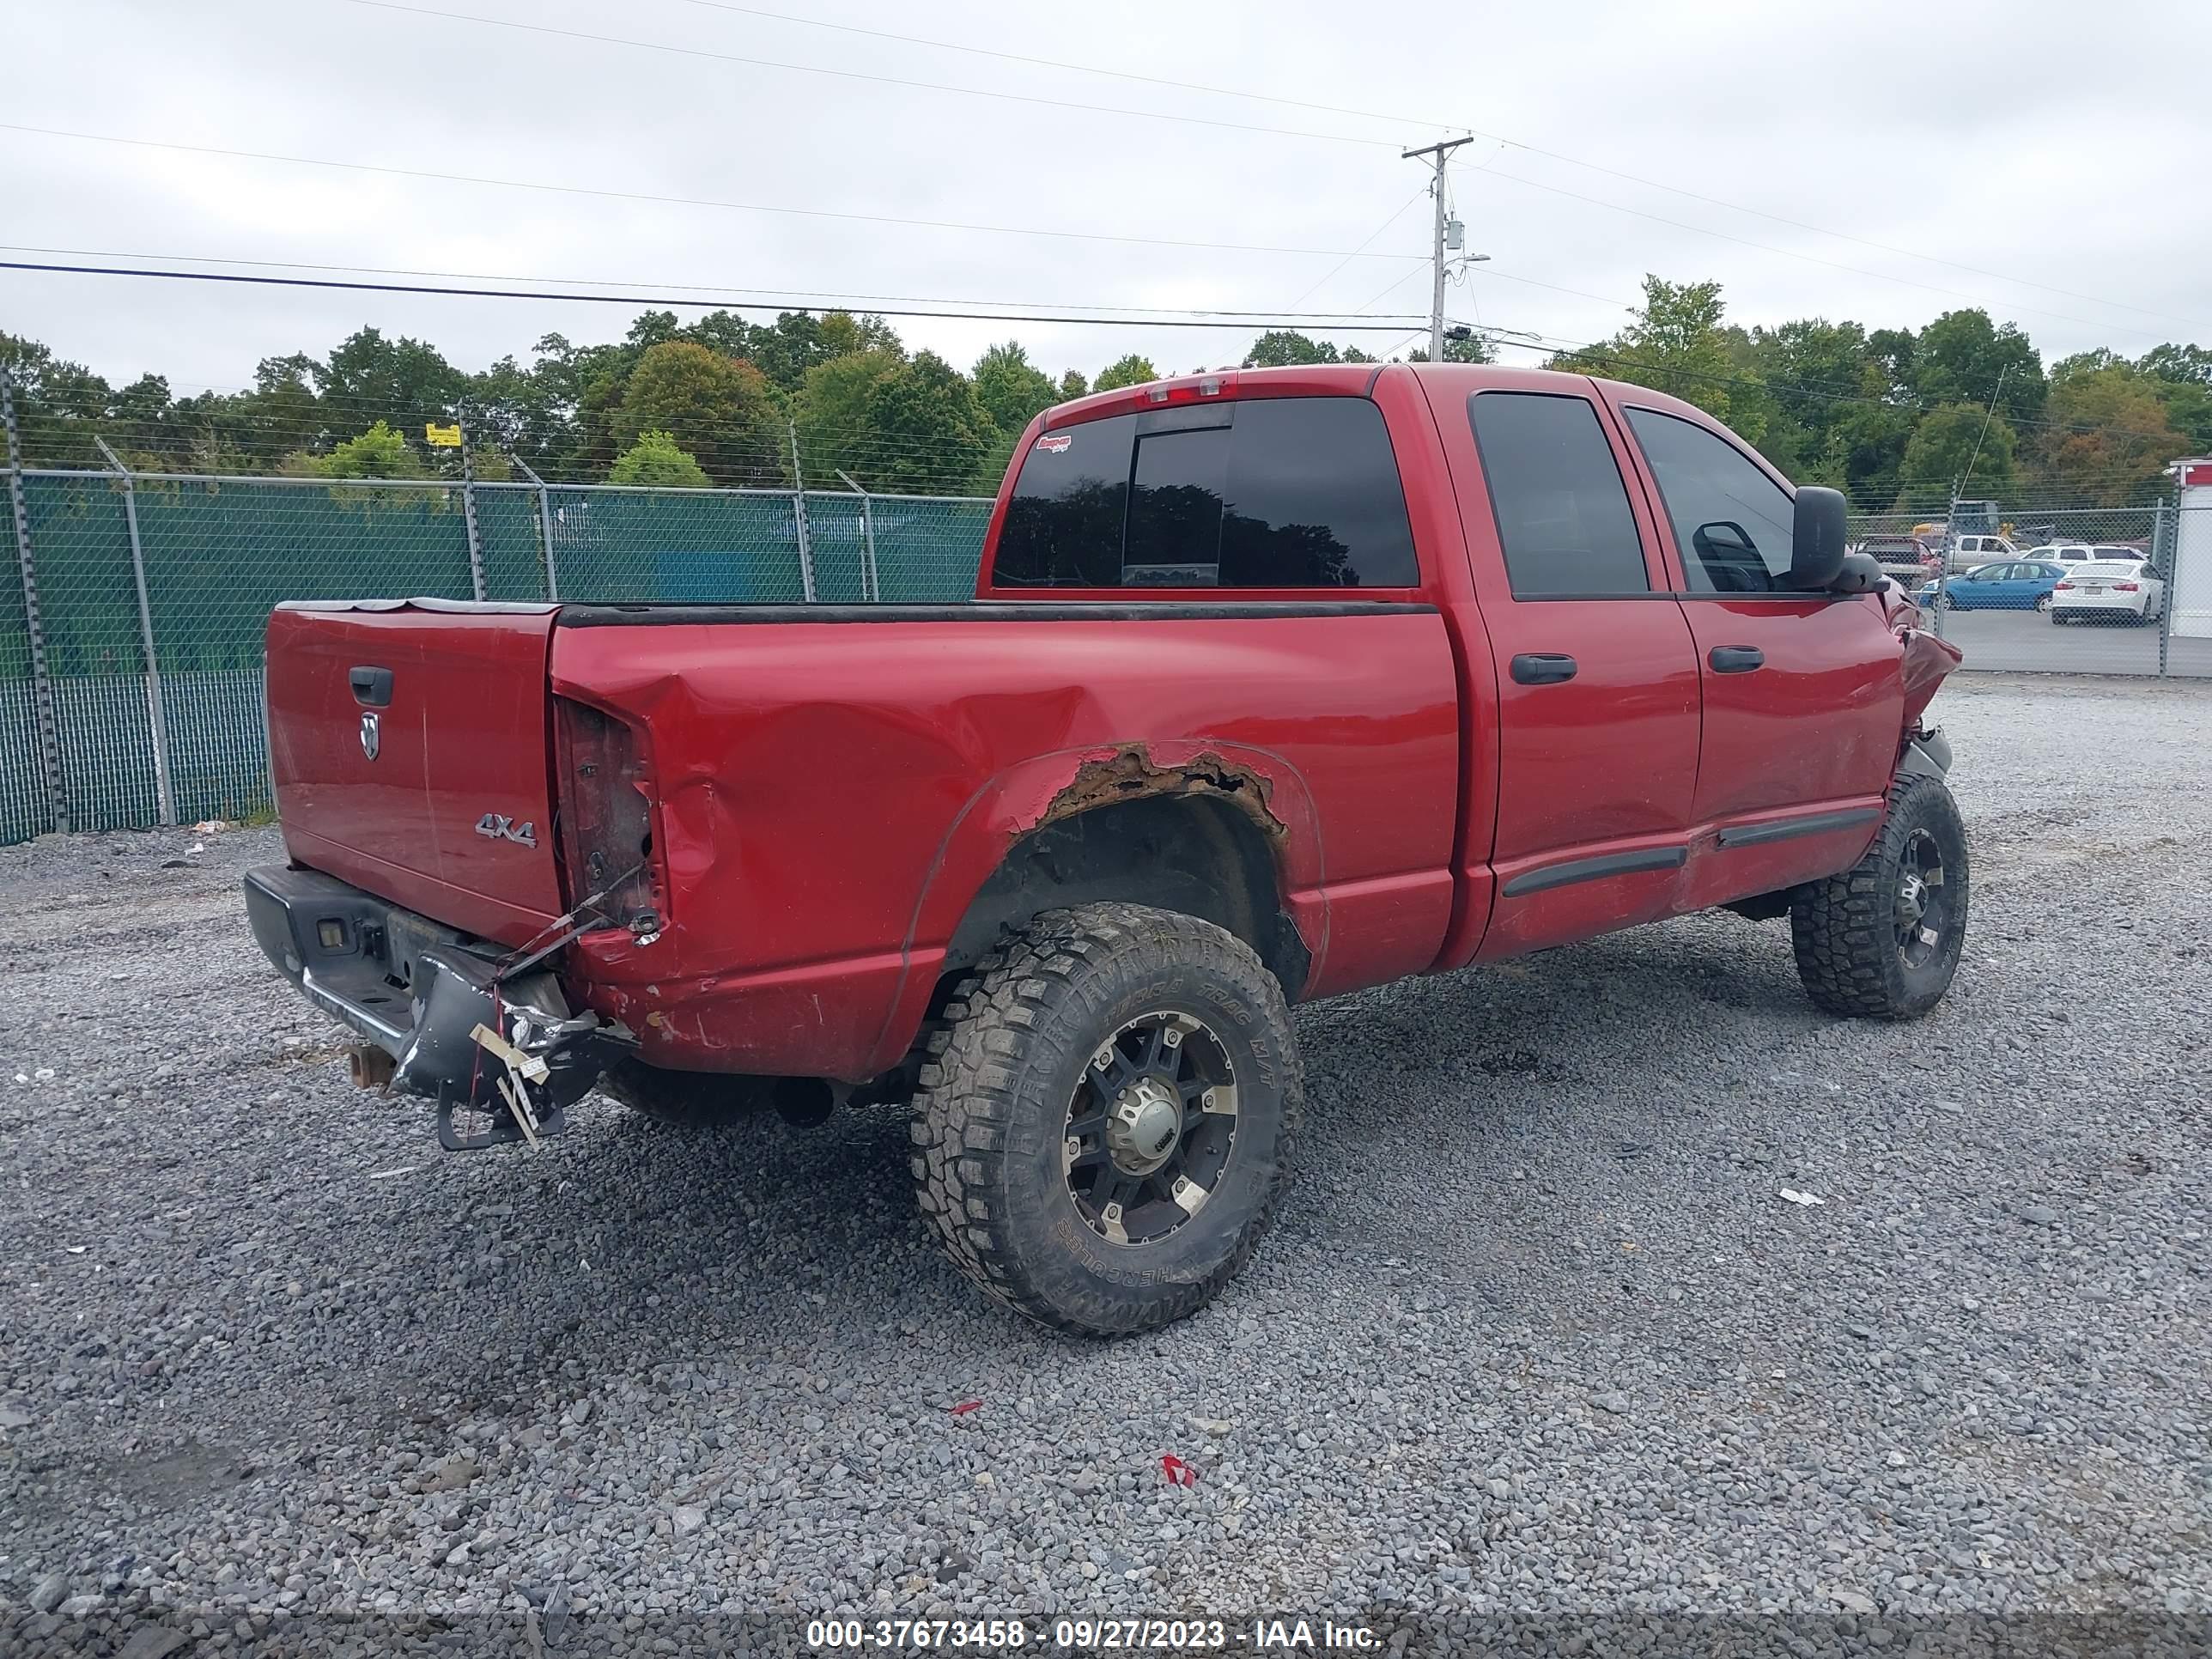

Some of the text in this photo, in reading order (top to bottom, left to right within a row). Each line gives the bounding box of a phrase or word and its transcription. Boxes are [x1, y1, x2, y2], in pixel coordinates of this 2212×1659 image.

[475, 813, 537, 849] 4X4
[1249, 1038, 1275, 1091] M/T
[1056, 1217, 1174, 1288] HERCULES
